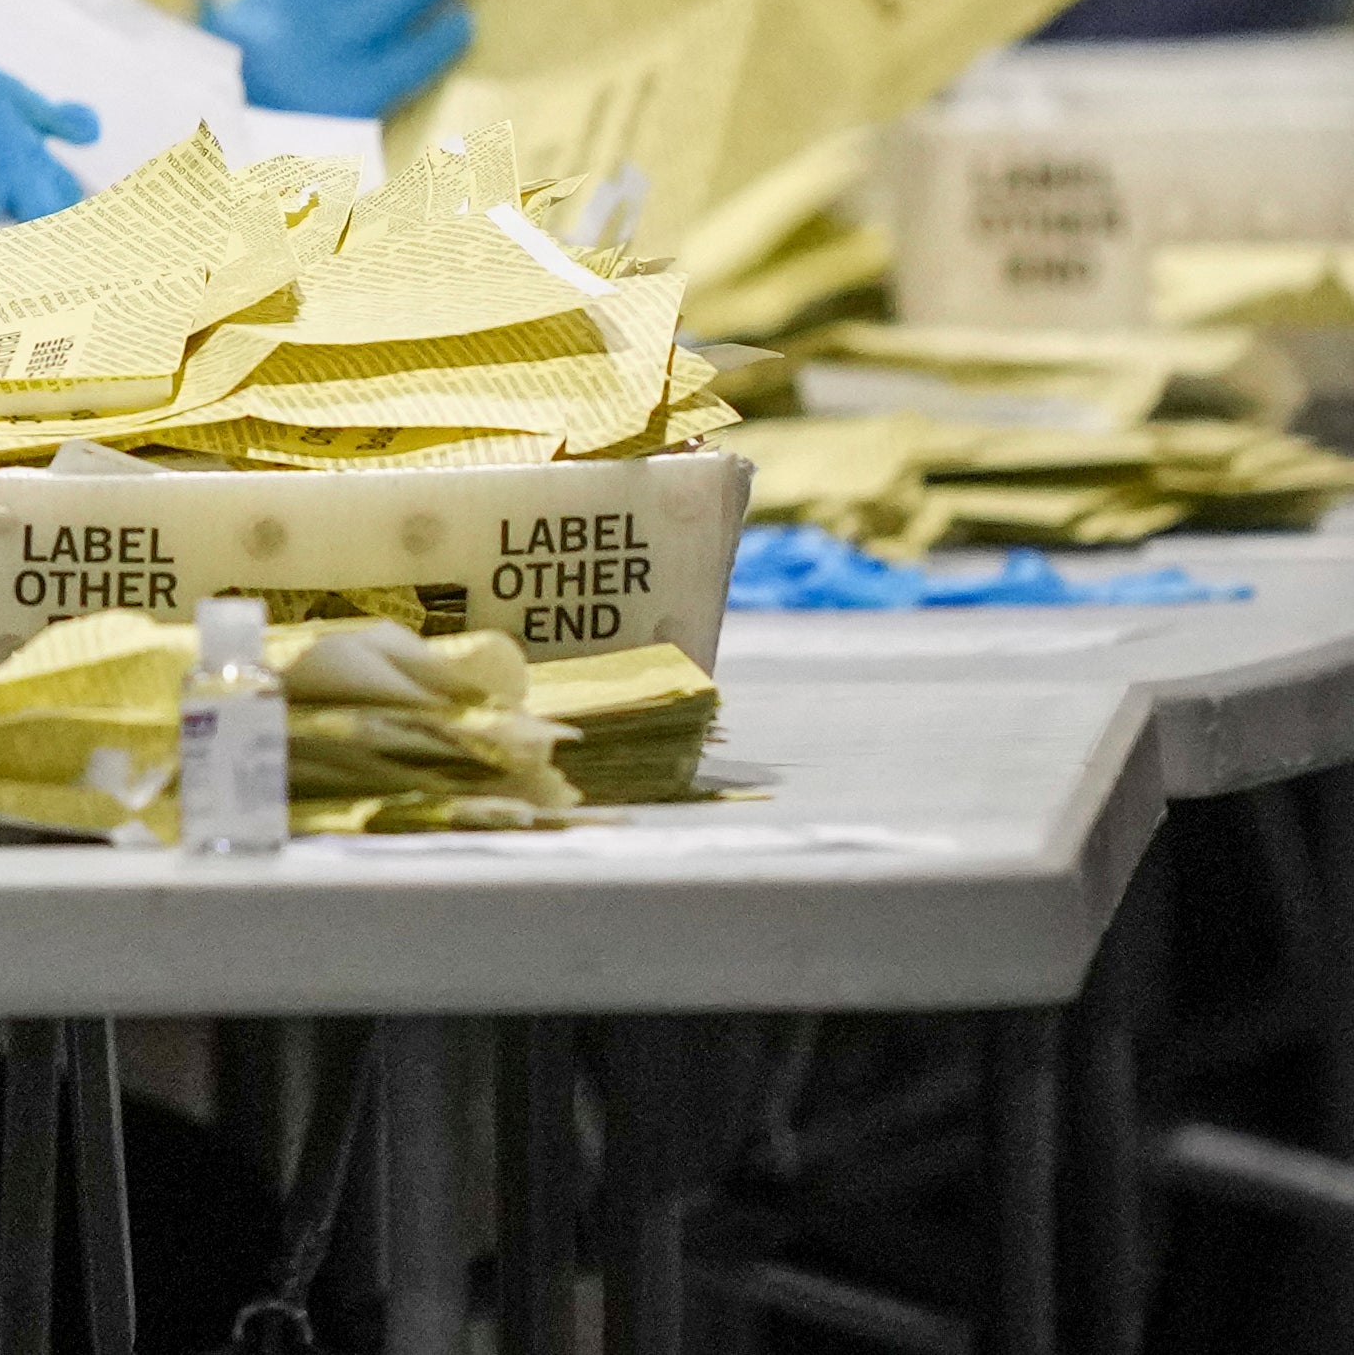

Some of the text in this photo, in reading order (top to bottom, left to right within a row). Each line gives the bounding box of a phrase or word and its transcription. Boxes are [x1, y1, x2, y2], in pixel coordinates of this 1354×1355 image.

[23, 524, 175, 563] LABEL
[500, 512, 649, 556] LABEL
[14, 570, 178, 608] OTHER
[492, 557, 651, 600] OTHER
[524, 603, 621, 643] END
